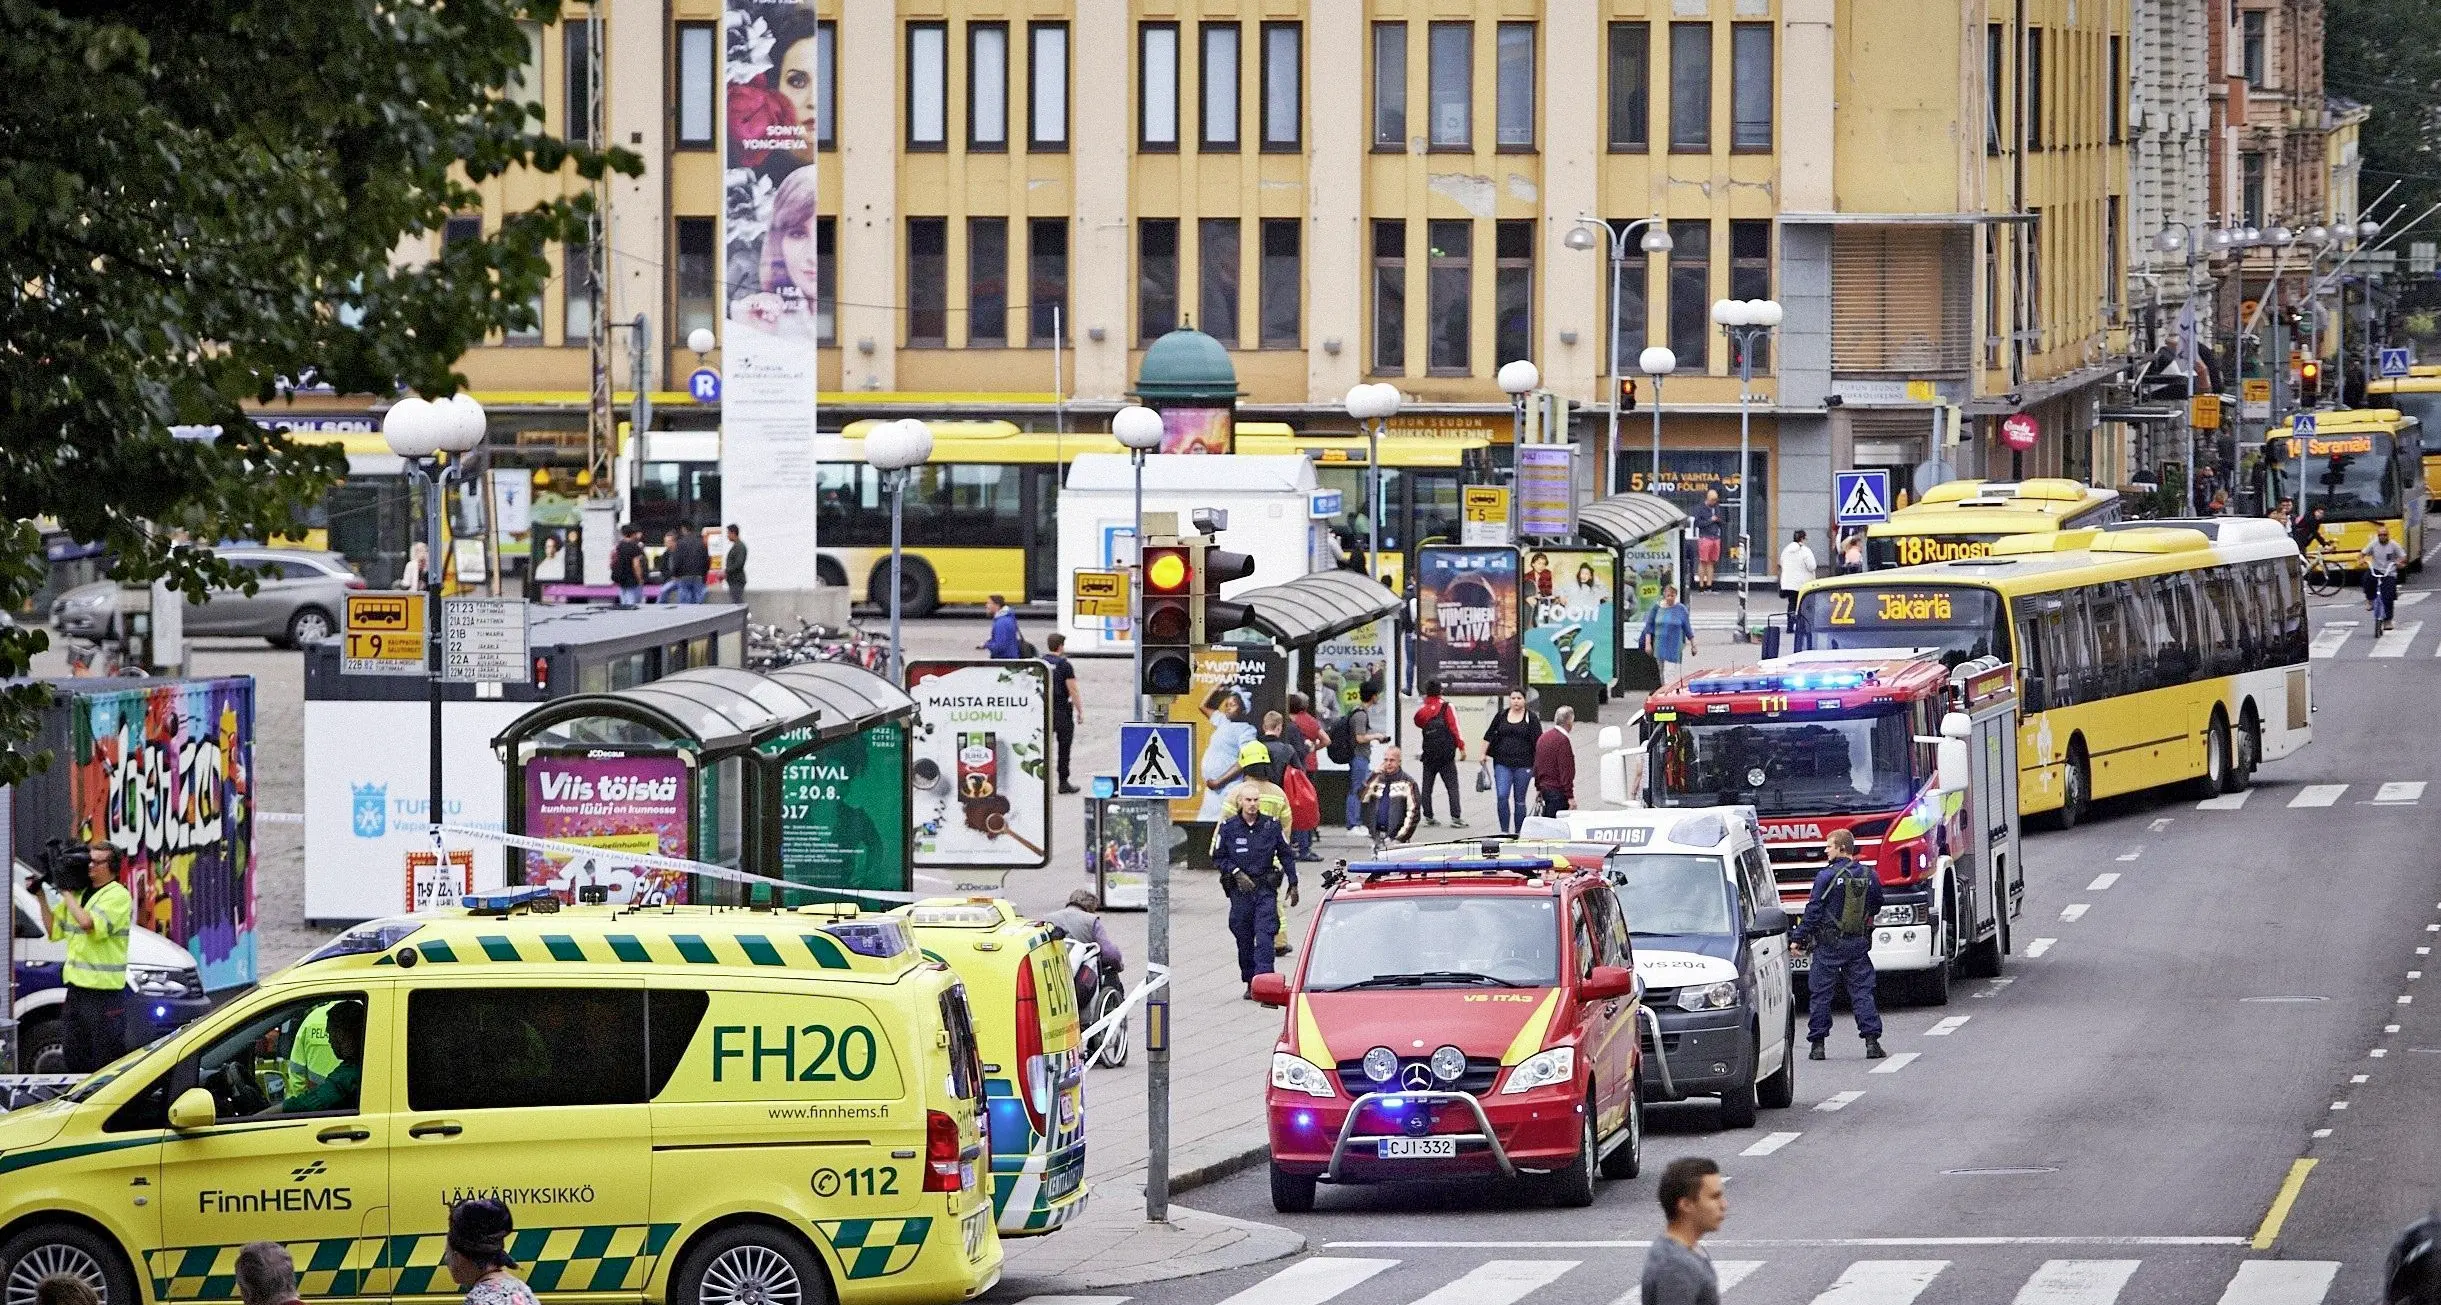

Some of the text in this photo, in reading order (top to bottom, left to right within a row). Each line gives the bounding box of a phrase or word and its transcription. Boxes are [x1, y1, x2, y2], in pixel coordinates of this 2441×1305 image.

[766, 126, 806, 136] SONYA
[742, 139, 807, 149] YONCHEVA
[1631, 473, 1644, 492] 5
[1897, 536, 1923, 565] 18
[1091, 599, 1098, 615] 7
[1830, 592, 1952, 624] 22 Jäkärlä
[450, 629, 466, 639] 21B
[347, 634, 382, 658] T 9
[450, 641, 463, 651] 22
[450, 654, 469, 664] 22A
[929, 696, 1029, 707] MAISTA REILU
[1758, 696, 1788, 712] T11
[951, 711, 1007, 721] LUOMU.
[588, 750, 626, 758] JCDecaux
[540, 771, 677, 801] Viis töistä
[541, 804, 579, 814] kunhan
[580, 802, 614, 815] lüüri
[628, 805, 677, 815] kunnossa
[1593, 829, 1647, 843] POLIISI
[1643, 961, 1706, 970] VS 204
[1464, 994, 1489, 1002] VS
[713, 1024, 877, 1082] FH20
[768, 1104, 890, 1119] www.finnhems.fi
[844, 1166, 899, 1196] 112
[199, 1187, 353, 1214] FinnHEMS
[441, 1184, 596, 1206] LÄÄKÄRIYKSIKKÖ
